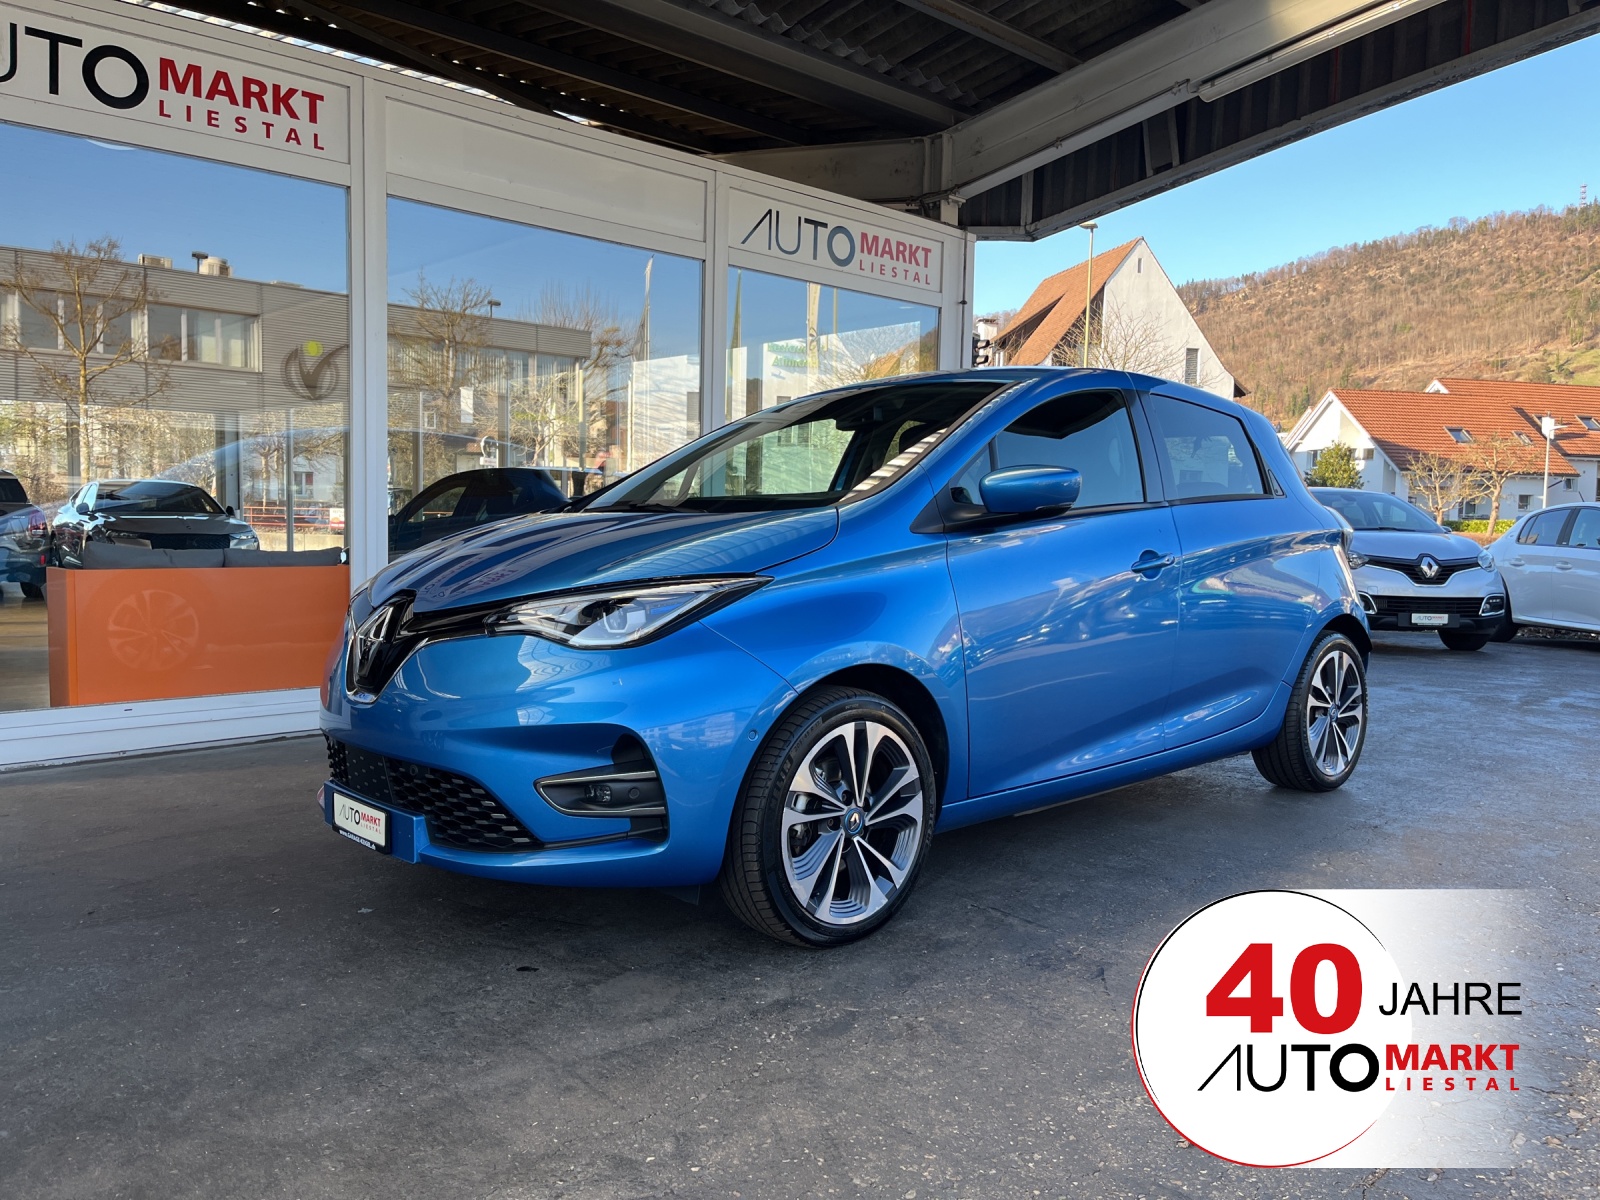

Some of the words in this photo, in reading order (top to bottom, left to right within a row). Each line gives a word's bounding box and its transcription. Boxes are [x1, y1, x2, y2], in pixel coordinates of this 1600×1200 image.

[0, 22, 149, 109] TO
[159, 57, 324, 124] MARKT
[159, 100, 324, 150] LIESTAL
[740, 208, 856, 268] AUTO
[860, 231, 932, 268] MARKT
[859, 259, 931, 285] LIESTAL
[339, 804, 360, 825] AUTO
[360, 811, 381, 827] MARKT
[360, 822, 382, 835] LIESTAL
